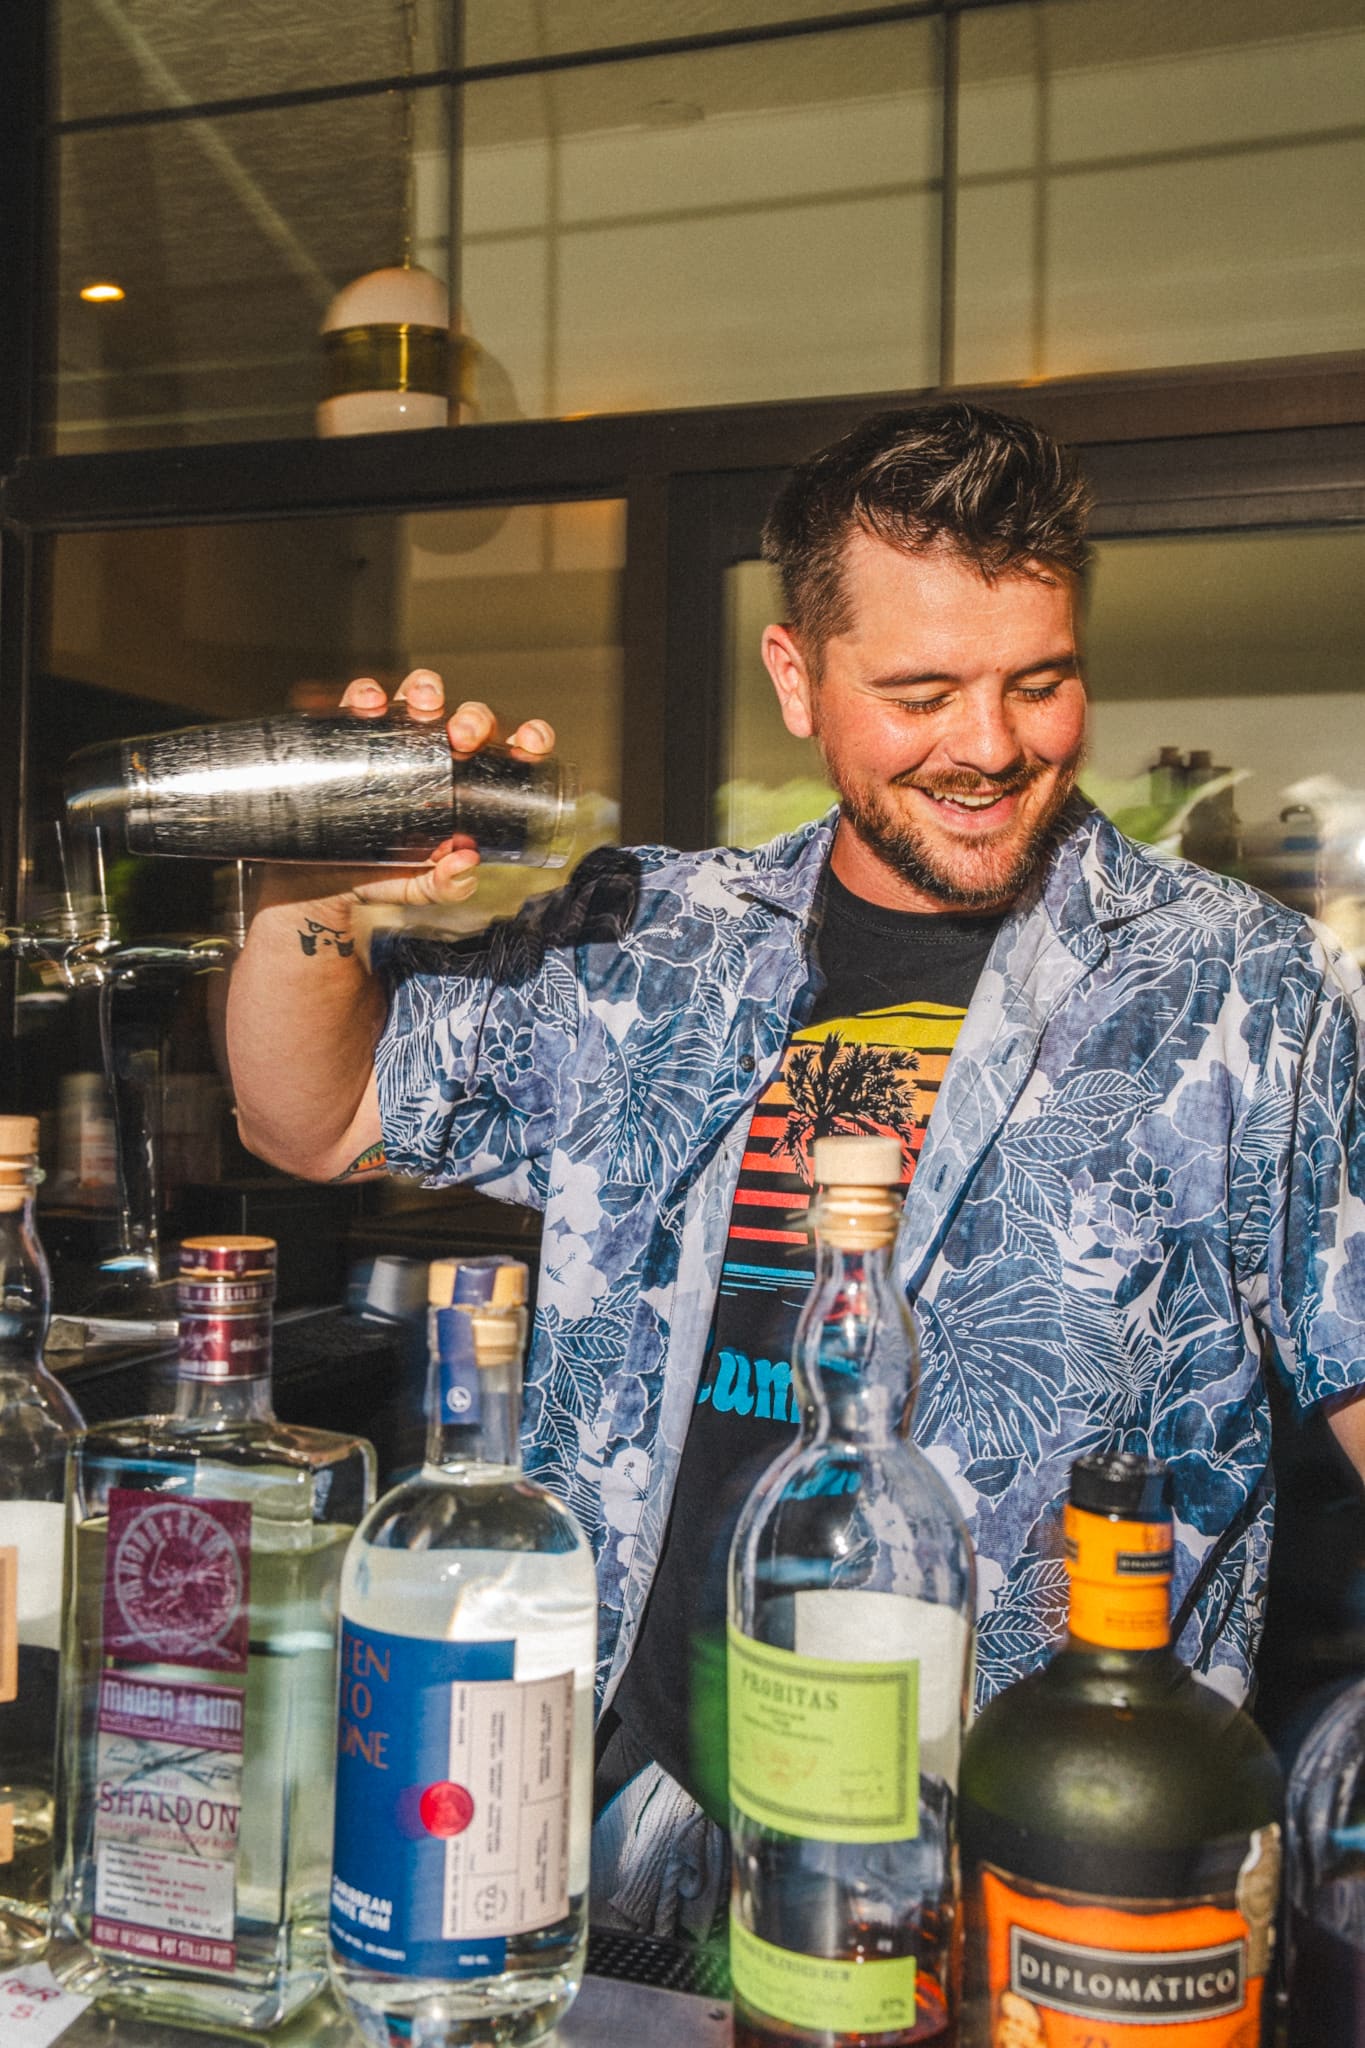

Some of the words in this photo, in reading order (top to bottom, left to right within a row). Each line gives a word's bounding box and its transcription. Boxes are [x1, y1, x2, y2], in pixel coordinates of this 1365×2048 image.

[343, 1632, 391, 1682] TEN
[102, 1680, 176, 1721] MHOBA
[194, 1693, 242, 1731] RUM
[341, 1673, 372, 1719] TO
[741, 1668, 838, 1711] PROBITAS
[99, 1780, 239, 1834] SHALDON
[358, 1906, 391, 1933] RUM
[1020, 1952, 1236, 2002] DIPLOMÁTICO
